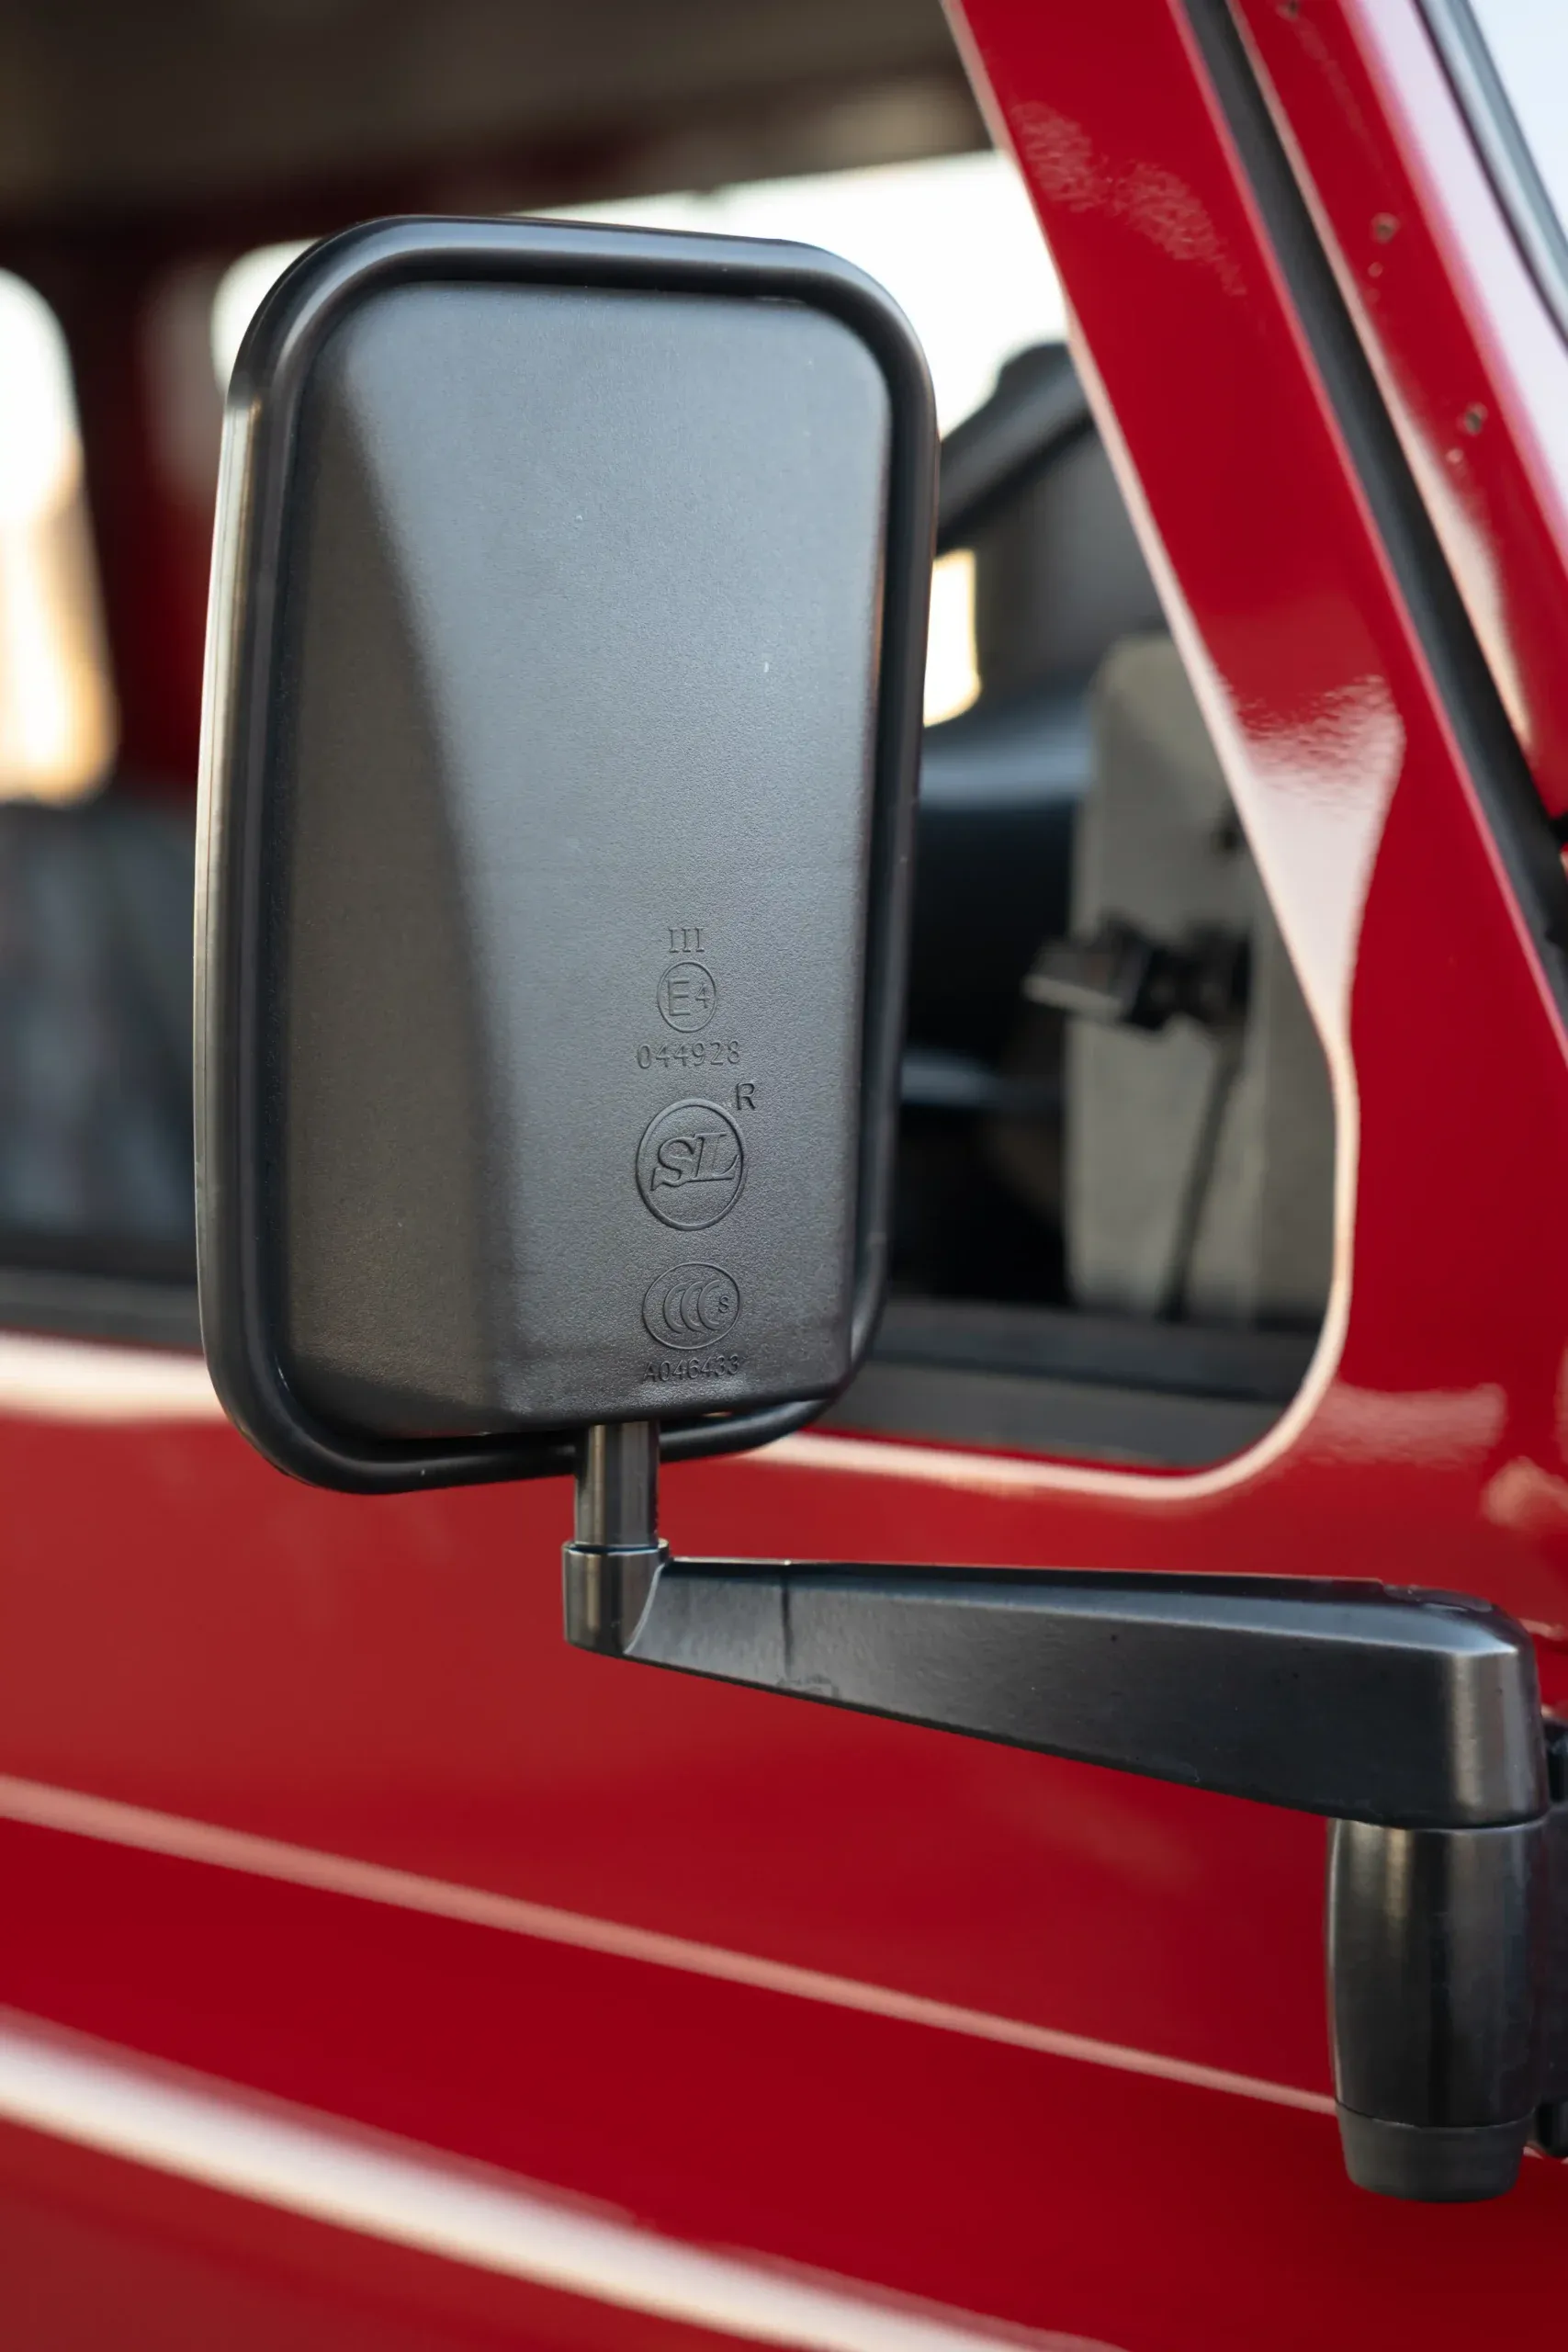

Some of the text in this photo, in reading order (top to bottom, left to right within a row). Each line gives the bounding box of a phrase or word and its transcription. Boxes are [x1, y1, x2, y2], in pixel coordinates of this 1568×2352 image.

[668, 926, 705, 953] III
[637, 1040, 740, 1069] 044928
[736, 1082, 756, 1110] R
[642, 1354, 739, 1382] A046433
